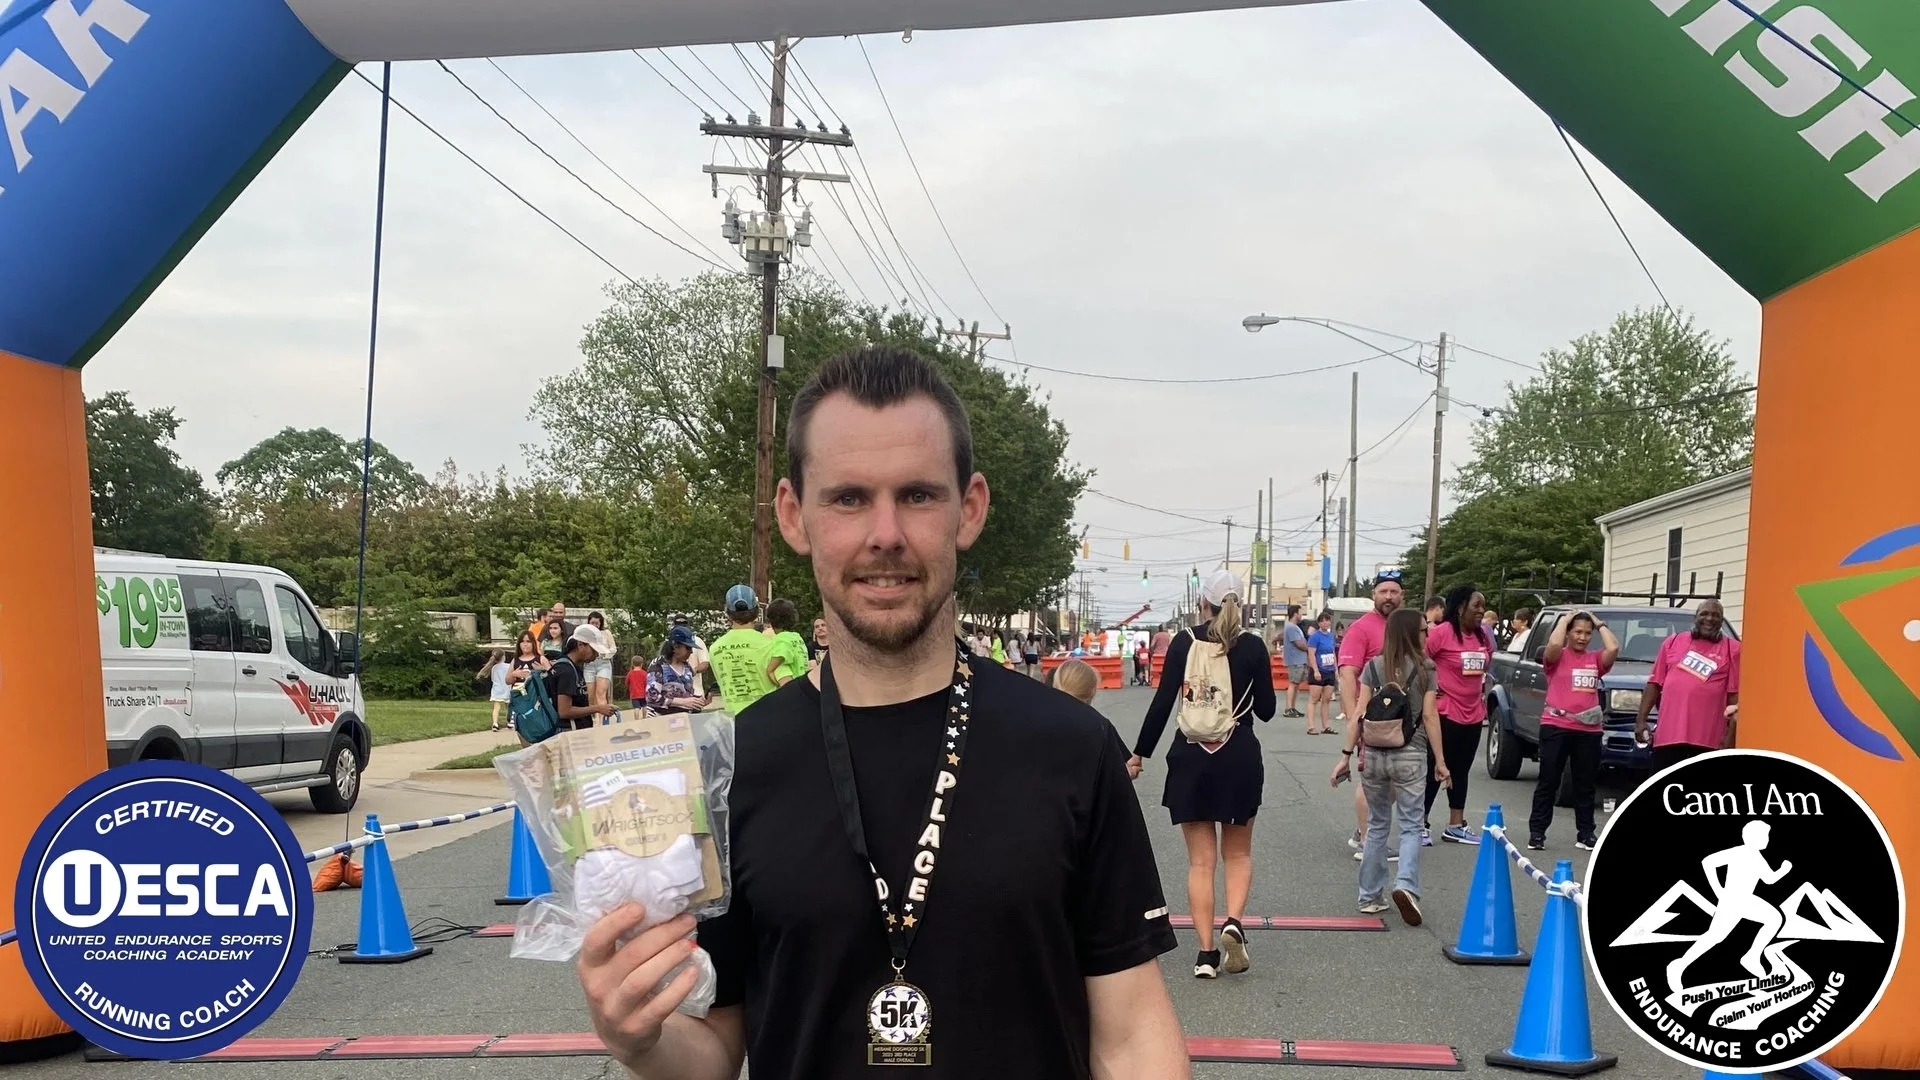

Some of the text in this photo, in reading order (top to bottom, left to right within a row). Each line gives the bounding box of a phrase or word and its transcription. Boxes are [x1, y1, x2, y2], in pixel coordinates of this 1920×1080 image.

[0, 0, 151, 173] AK
[1653, 0, 1920, 203] ISH
[159, 620, 186, 631] IN-TOWN
[1463, 659, 1485, 670] 5967
[1682, 656, 1712, 677] 6113
[106, 696, 125, 707] Truck
[126, 695, 146, 707] Share
[308, 685, 351, 702] U-HAUL
[585, 742, 684, 768] DOUBLE LAYER
[908, 770, 957, 901] PLACE
[880, 1000, 918, 1028] 5K
